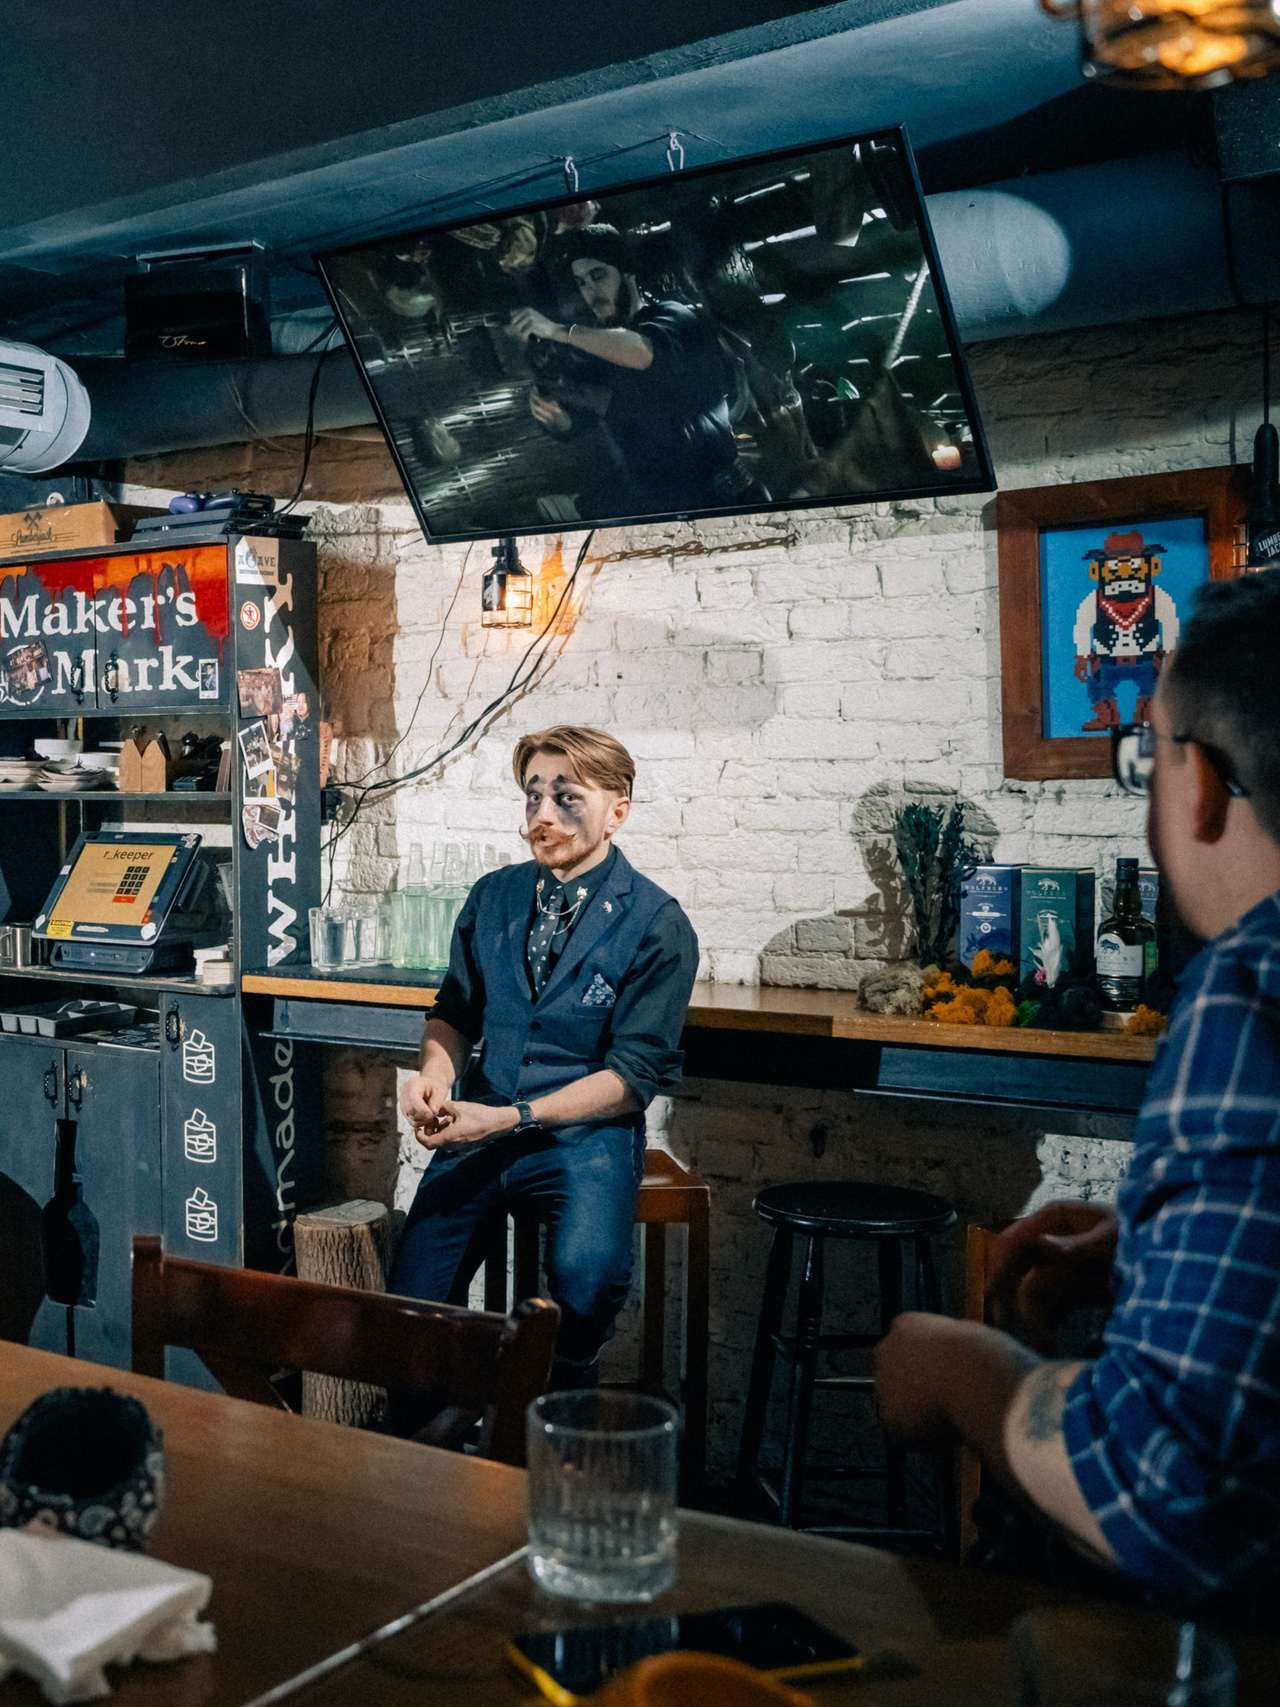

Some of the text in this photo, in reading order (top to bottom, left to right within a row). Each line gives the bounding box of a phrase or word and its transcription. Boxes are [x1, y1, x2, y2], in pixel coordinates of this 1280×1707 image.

[238, 547, 276, 568] AGAVE
[51, 645, 201, 695] Mark
[103, 849, 154, 862] r_keeper
